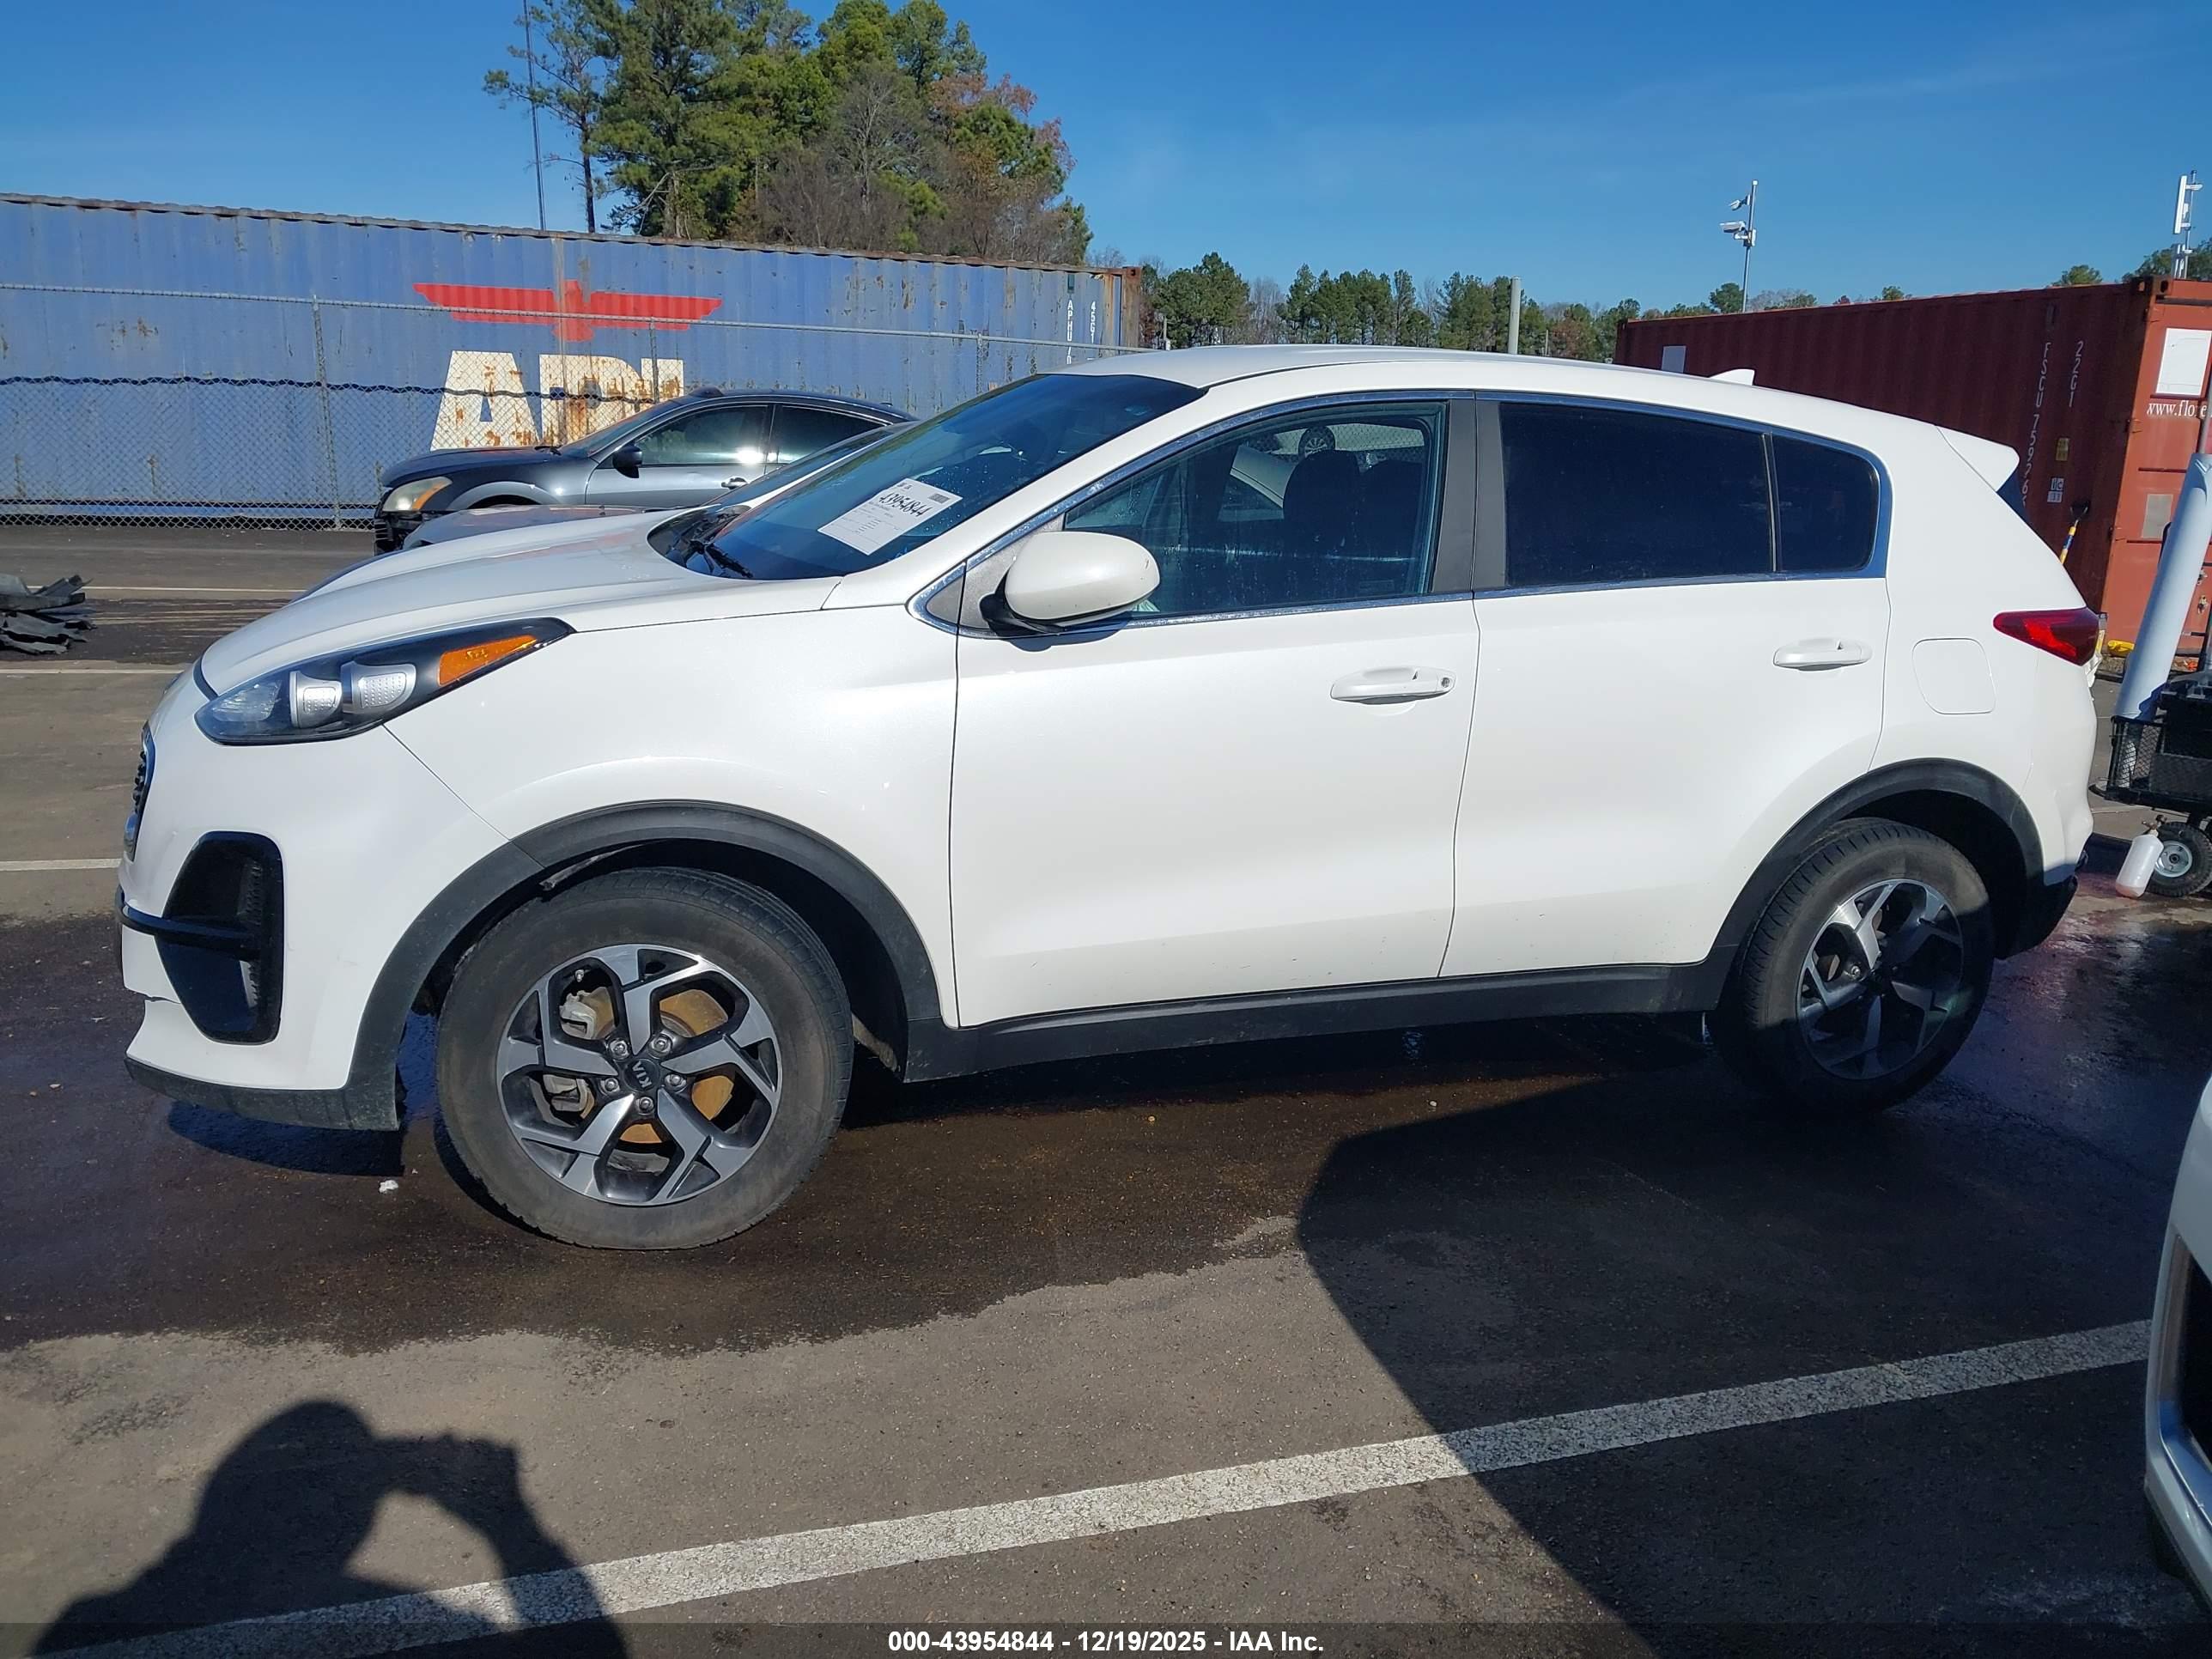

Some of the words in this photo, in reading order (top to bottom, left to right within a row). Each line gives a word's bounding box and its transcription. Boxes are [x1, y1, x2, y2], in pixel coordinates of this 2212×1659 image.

[2035, 342, 2051, 409] FSCU
[2069, 340, 2084, 408] 22G1
[878, 492, 933, 517] 43954844
[632, 1060, 653, 1088] KIA
